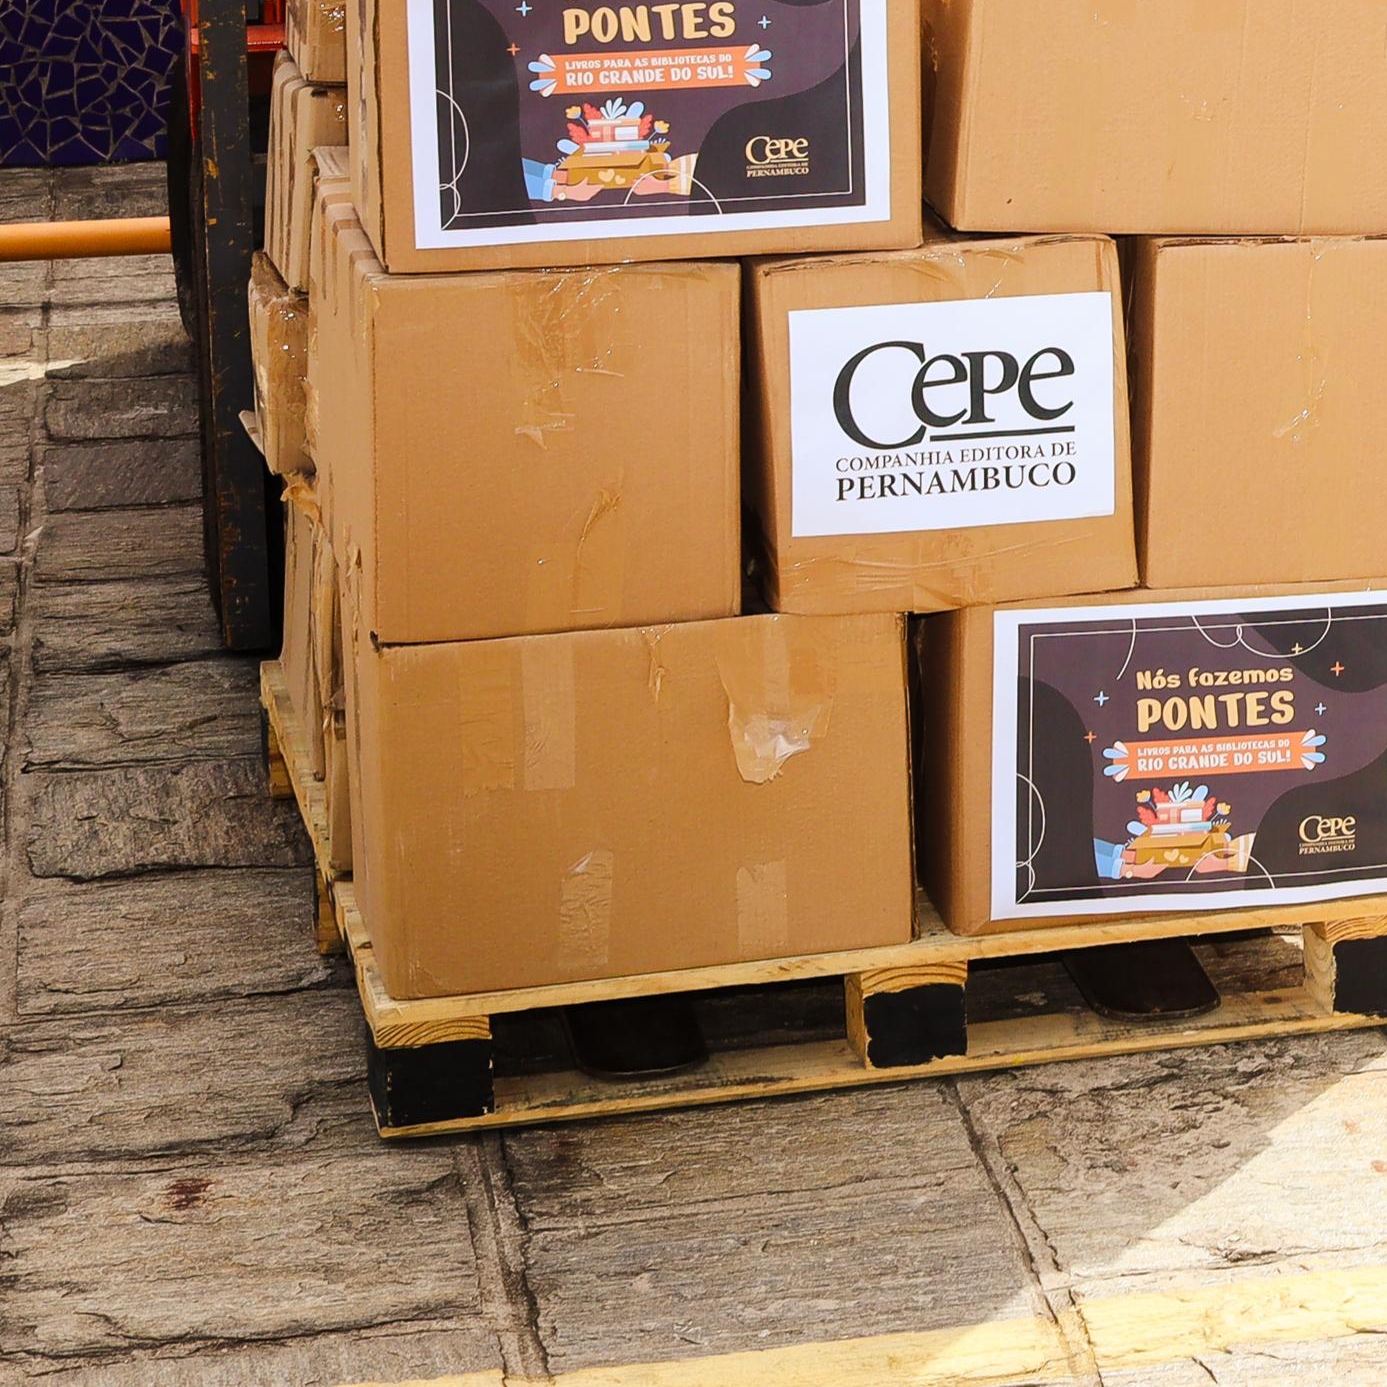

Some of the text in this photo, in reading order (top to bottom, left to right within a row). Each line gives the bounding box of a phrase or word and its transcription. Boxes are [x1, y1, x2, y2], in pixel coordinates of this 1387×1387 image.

[562, 1, 735, 44] PONTES
[564, 52, 732, 70] LIVROS PARA AS BIBLIOTECAS DO
[565, 64, 733, 86] RIO GRANDE DO SUL!
[746, 166, 809, 178] PERNAMBUCO
[836, 441, 1076, 472] COMPANHIA EDITORA DE
[836, 461, 1076, 501] PERNAMBUCO
[1136, 667, 1293, 689] Nós fazemos
[1136, 689, 1294, 732] PONTES
[1136, 737, 1290, 756] LIVROS PARA AS BIBLIOTECAS DO
[1136, 749, 1290, 771] RIO GRANDE DO SUL!
[1297, 842, 1355, 854] PERNAMBUCO
